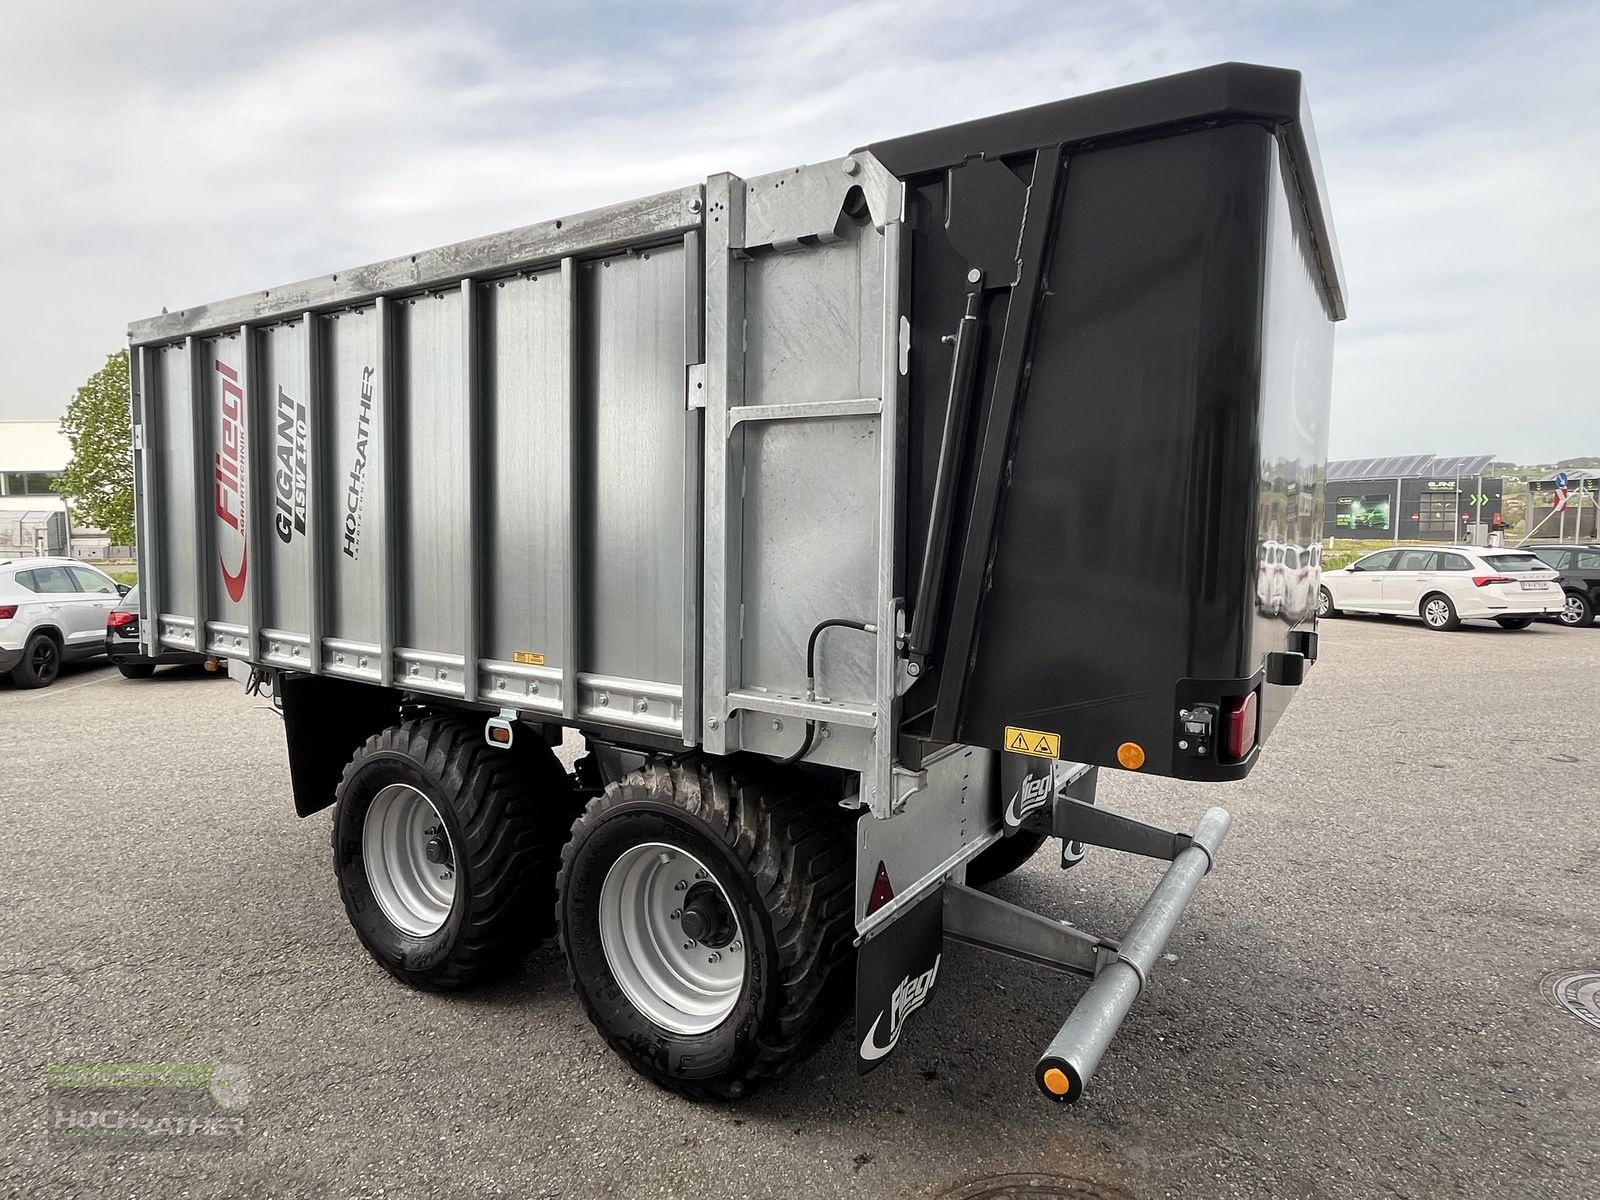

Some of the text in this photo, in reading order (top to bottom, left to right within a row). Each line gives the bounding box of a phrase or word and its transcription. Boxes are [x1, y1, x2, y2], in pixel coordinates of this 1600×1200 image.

[213, 359, 244, 530] Fliegl
[275, 384, 294, 544] GIGANT
[295, 420, 307, 522] ASW 110
[343, 366, 375, 559] HOCHRATHER
